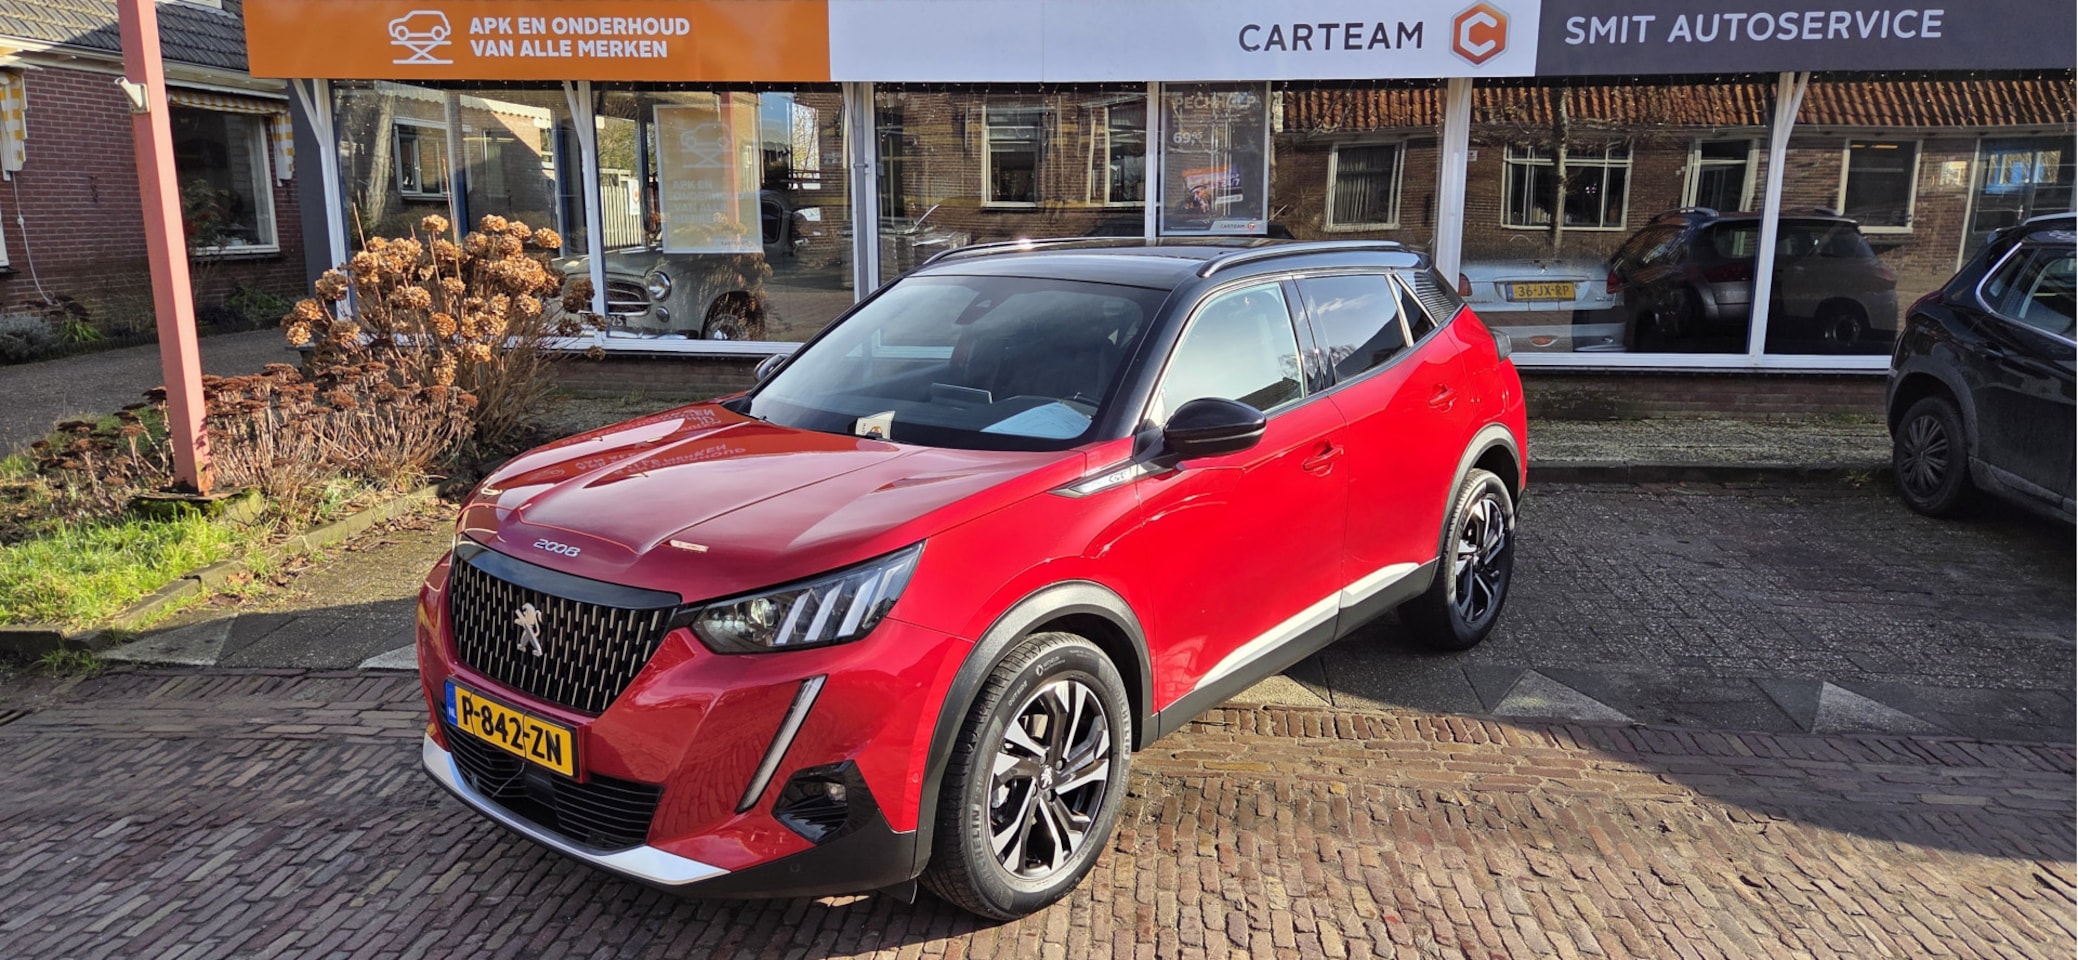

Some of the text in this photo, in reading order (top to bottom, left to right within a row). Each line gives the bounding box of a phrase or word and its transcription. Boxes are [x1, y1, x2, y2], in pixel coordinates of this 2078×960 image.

[469, 17, 691, 36] APK EN ONDERHOUD
[1564, 9, 1945, 45] SMIT AUTOSERVICE
[1238, 21, 1424, 53] CARTEAM
[470, 39, 668, 58] VAN ALLE MERKEN
[1518, 285, 1570, 298] 36-JX-RP
[533, 538, 581, 558] 2008
[461, 695, 563, 767] P-842-ZN
